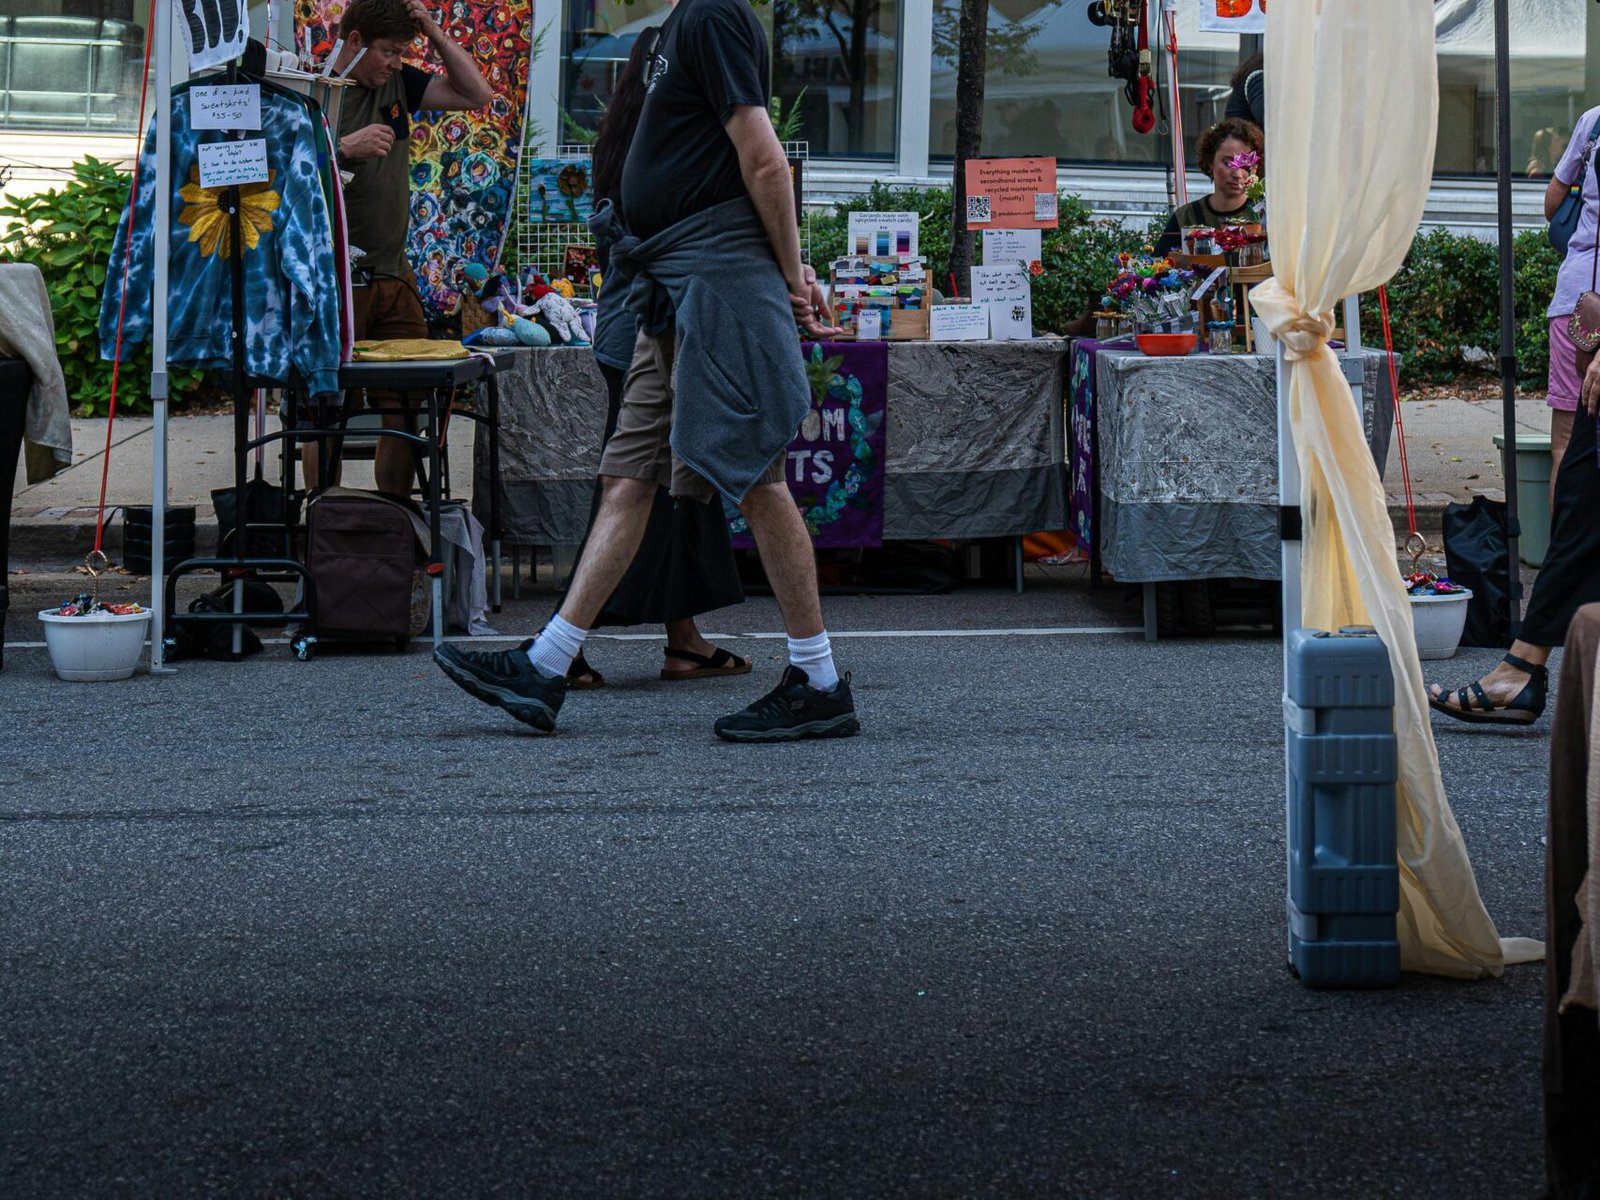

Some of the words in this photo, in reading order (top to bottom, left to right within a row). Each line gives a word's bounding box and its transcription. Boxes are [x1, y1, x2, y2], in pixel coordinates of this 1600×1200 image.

[233, 87, 250, 97] kind
[979, 168, 1010, 176] Everything
[984, 186, 1009, 194] recycled
[999, 194, 1025, 202] (mostly)
